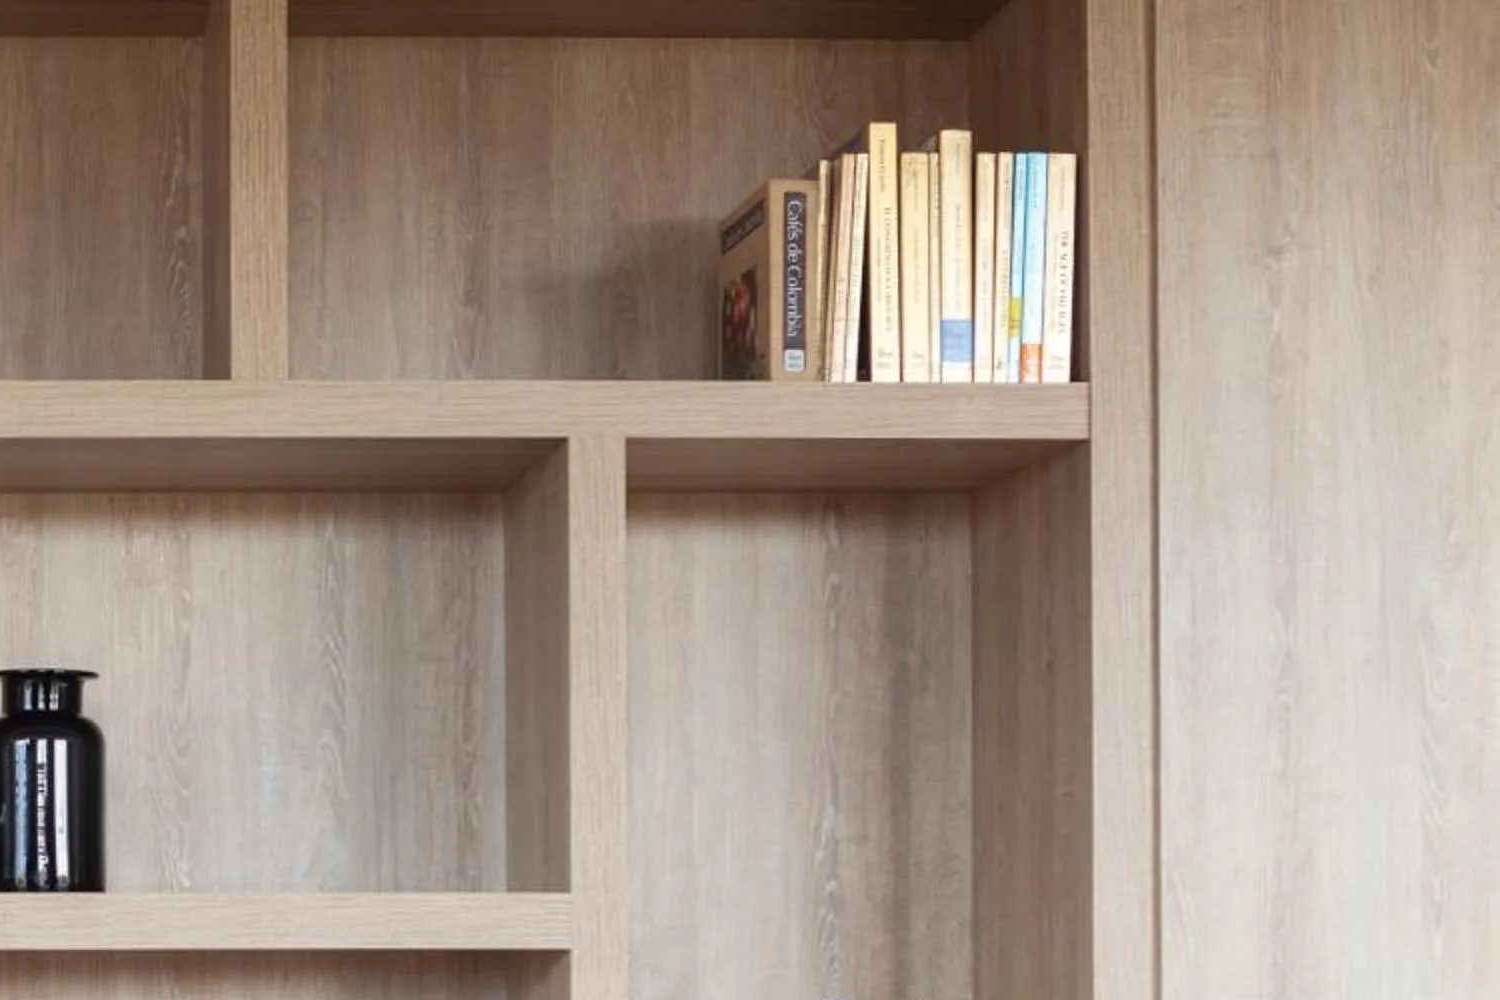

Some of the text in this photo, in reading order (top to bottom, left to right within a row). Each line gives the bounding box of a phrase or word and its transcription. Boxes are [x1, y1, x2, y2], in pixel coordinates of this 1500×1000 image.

[787, 201, 803, 241] Cafés
[787, 243, 802, 263] de
[787, 265, 802, 337] Colombia
